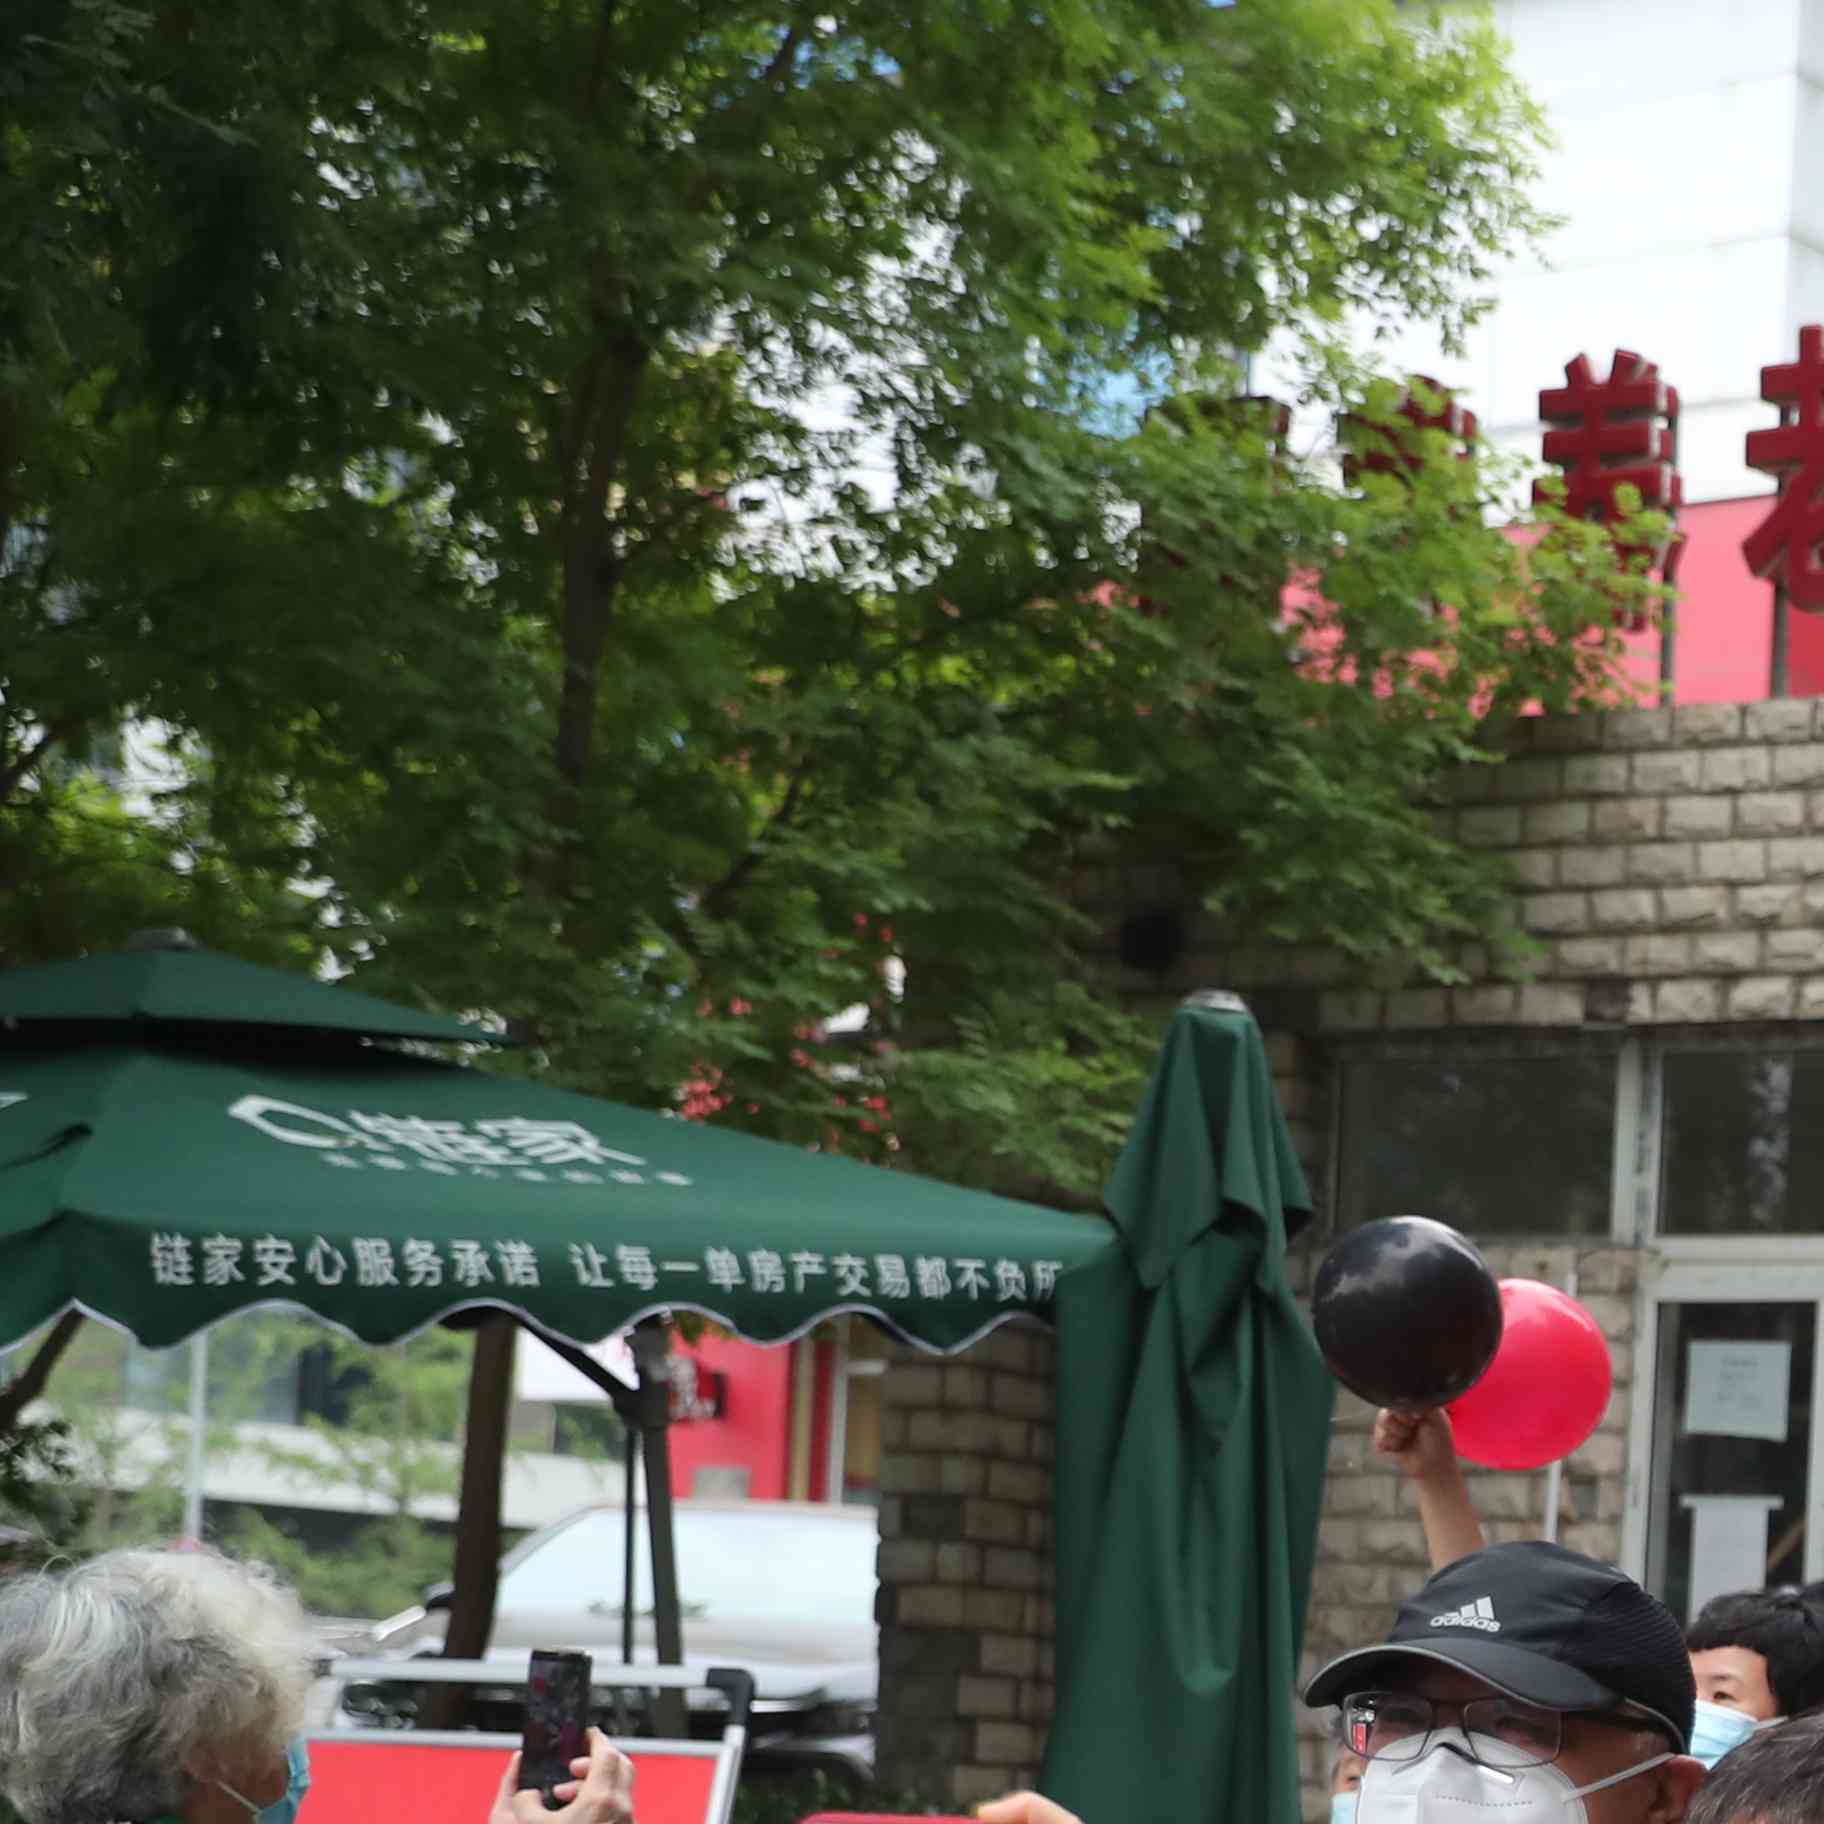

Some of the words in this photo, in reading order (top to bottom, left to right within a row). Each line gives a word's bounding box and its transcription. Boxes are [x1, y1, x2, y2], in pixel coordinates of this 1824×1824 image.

[150, 1231, 541, 1288] 链家安心服务承诺
[1430, 1614, 1501, 1632] adidas
